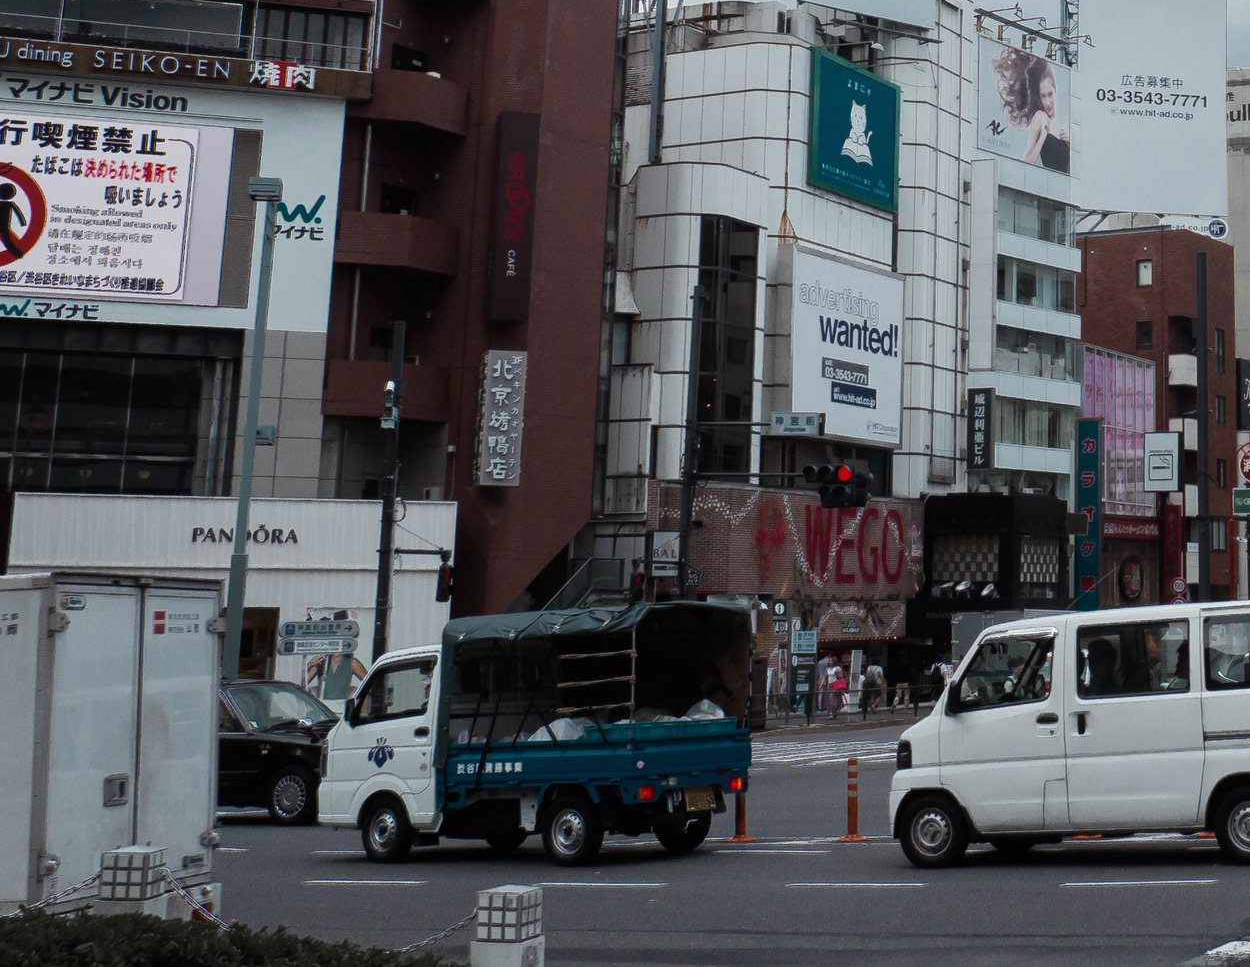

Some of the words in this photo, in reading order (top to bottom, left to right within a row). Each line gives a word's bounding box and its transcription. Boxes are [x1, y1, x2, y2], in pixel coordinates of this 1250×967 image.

[17, 43, 74, 68] dining
[94, 49, 232, 80] SEIKO-EN
[249, 59, 317, 90] 焼肉
[1120, 74, 1184, 90] 広告募集中
[6, 77, 94, 104] マイナビ
[101, 85, 189, 112] Vision
[1096, 88, 1208, 108] 03-3543-7771
[1119, 108, 1194, 121] www.hit-ad.co.jp
[0, 118, 166, 156] 行喫煙禁止
[104, 185, 183, 209] 吸いましょう
[51, 204, 100, 217] Smoking
[101, 208, 143, 219] allowed
[64, 215, 122, 228] designated
[122, 220, 152, 229] areas
[152, 223, 178, 231] only
[34, 302, 100, 320] マイナビ
[800, 280, 880, 326] advertising
[819, 315, 899, 358] wanted!
[825, 366, 868, 385] 03-3543-7771
[833, 392, 876, 409] www.hit-ad.co.jp
[192, 523, 299, 544] PANORA
[653, 548, 677, 559] BAL
[805, 503, 905, 585] WEGO
